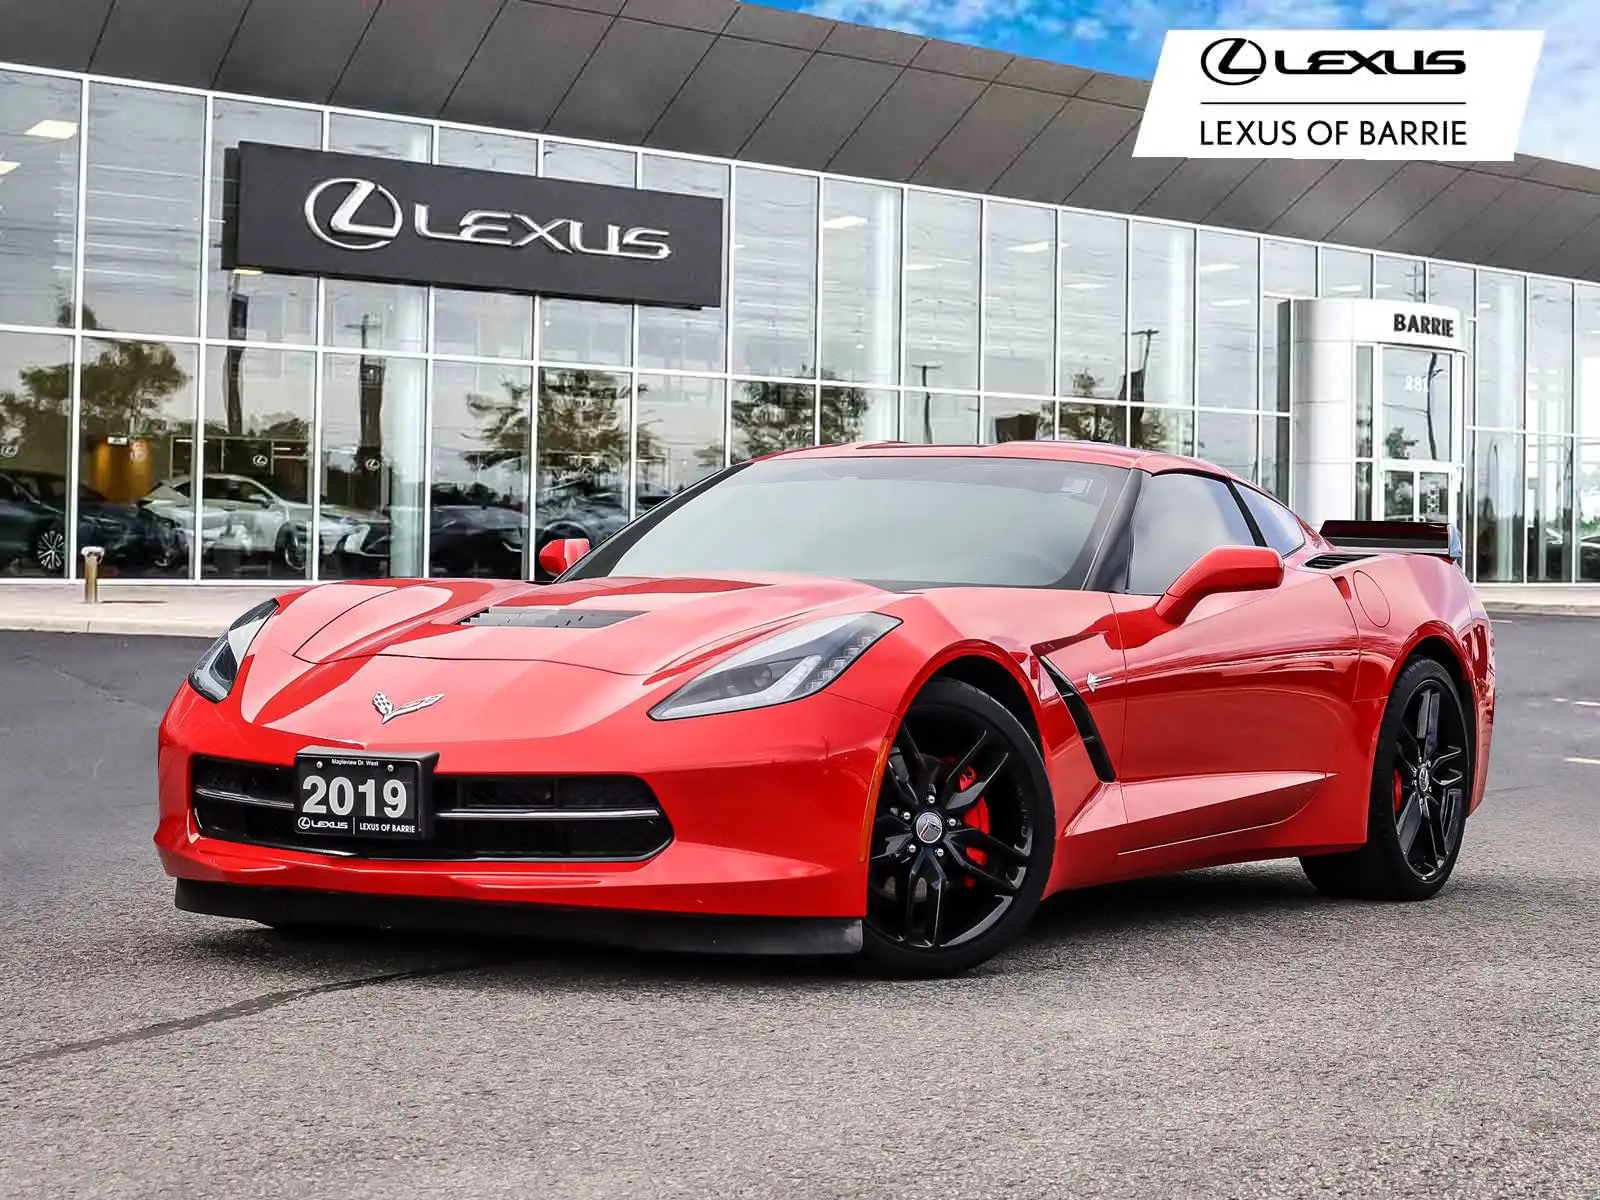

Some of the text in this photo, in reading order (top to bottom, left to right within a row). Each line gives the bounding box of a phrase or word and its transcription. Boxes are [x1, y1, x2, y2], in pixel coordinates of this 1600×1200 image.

[414, 203, 672, 260] LEXUS
[1393, 313, 1454, 338] BARRIE
[302, 775, 407, 818] 2019
[311, 820, 348, 829] LEXUS
[359, 822, 416, 834] LEXUS OF BARRIE
